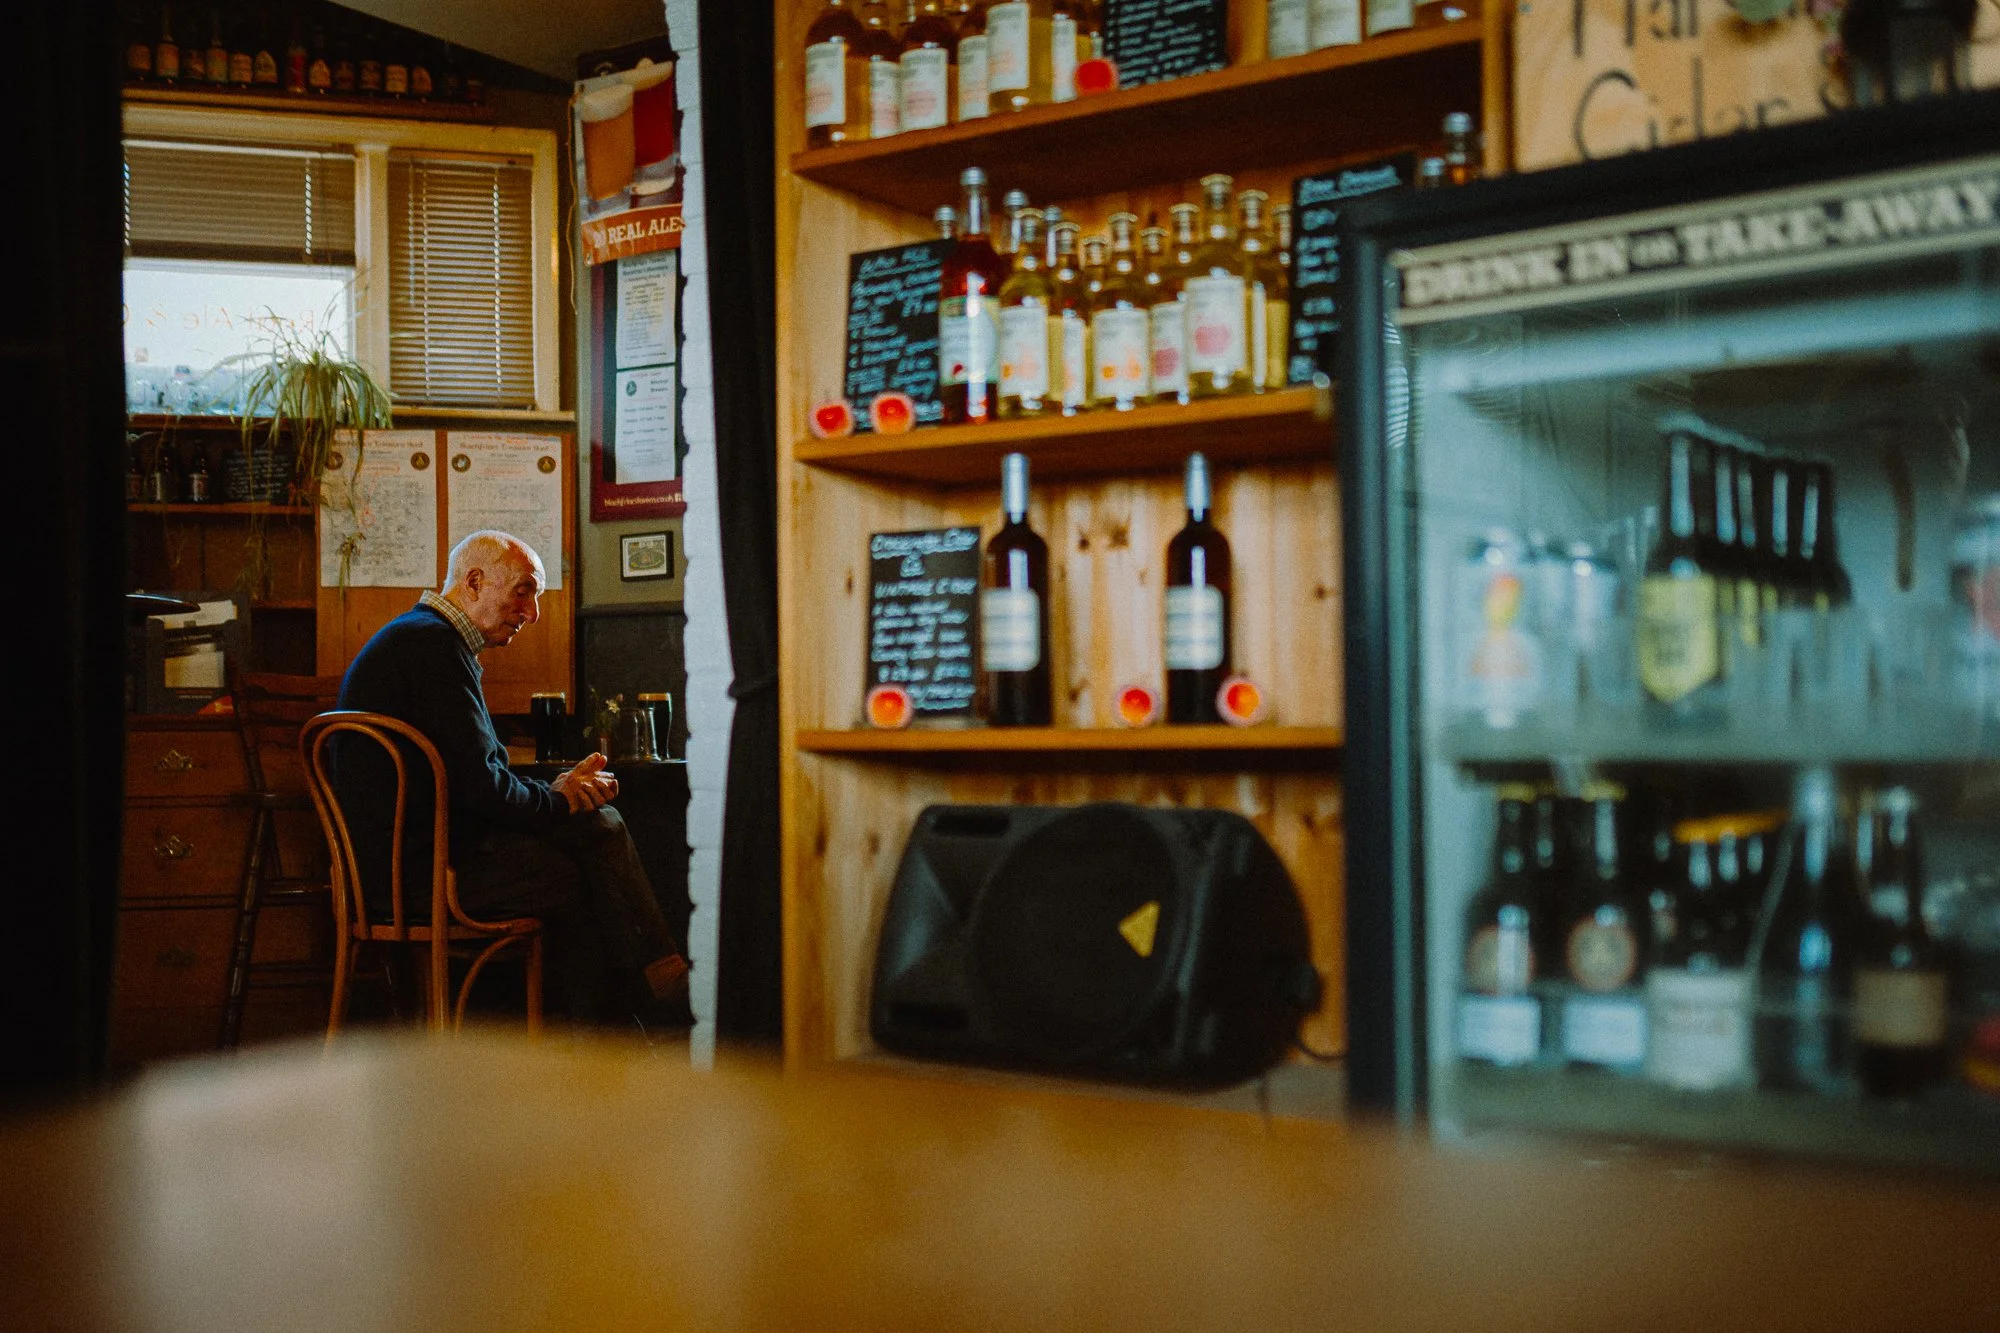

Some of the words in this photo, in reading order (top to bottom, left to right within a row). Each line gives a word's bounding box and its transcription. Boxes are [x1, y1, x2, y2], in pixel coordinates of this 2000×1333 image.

[607, 220, 646, 245] REAL
[1404, 244, 1564, 305] DRINK
[1567, 236, 1630, 284] IN
